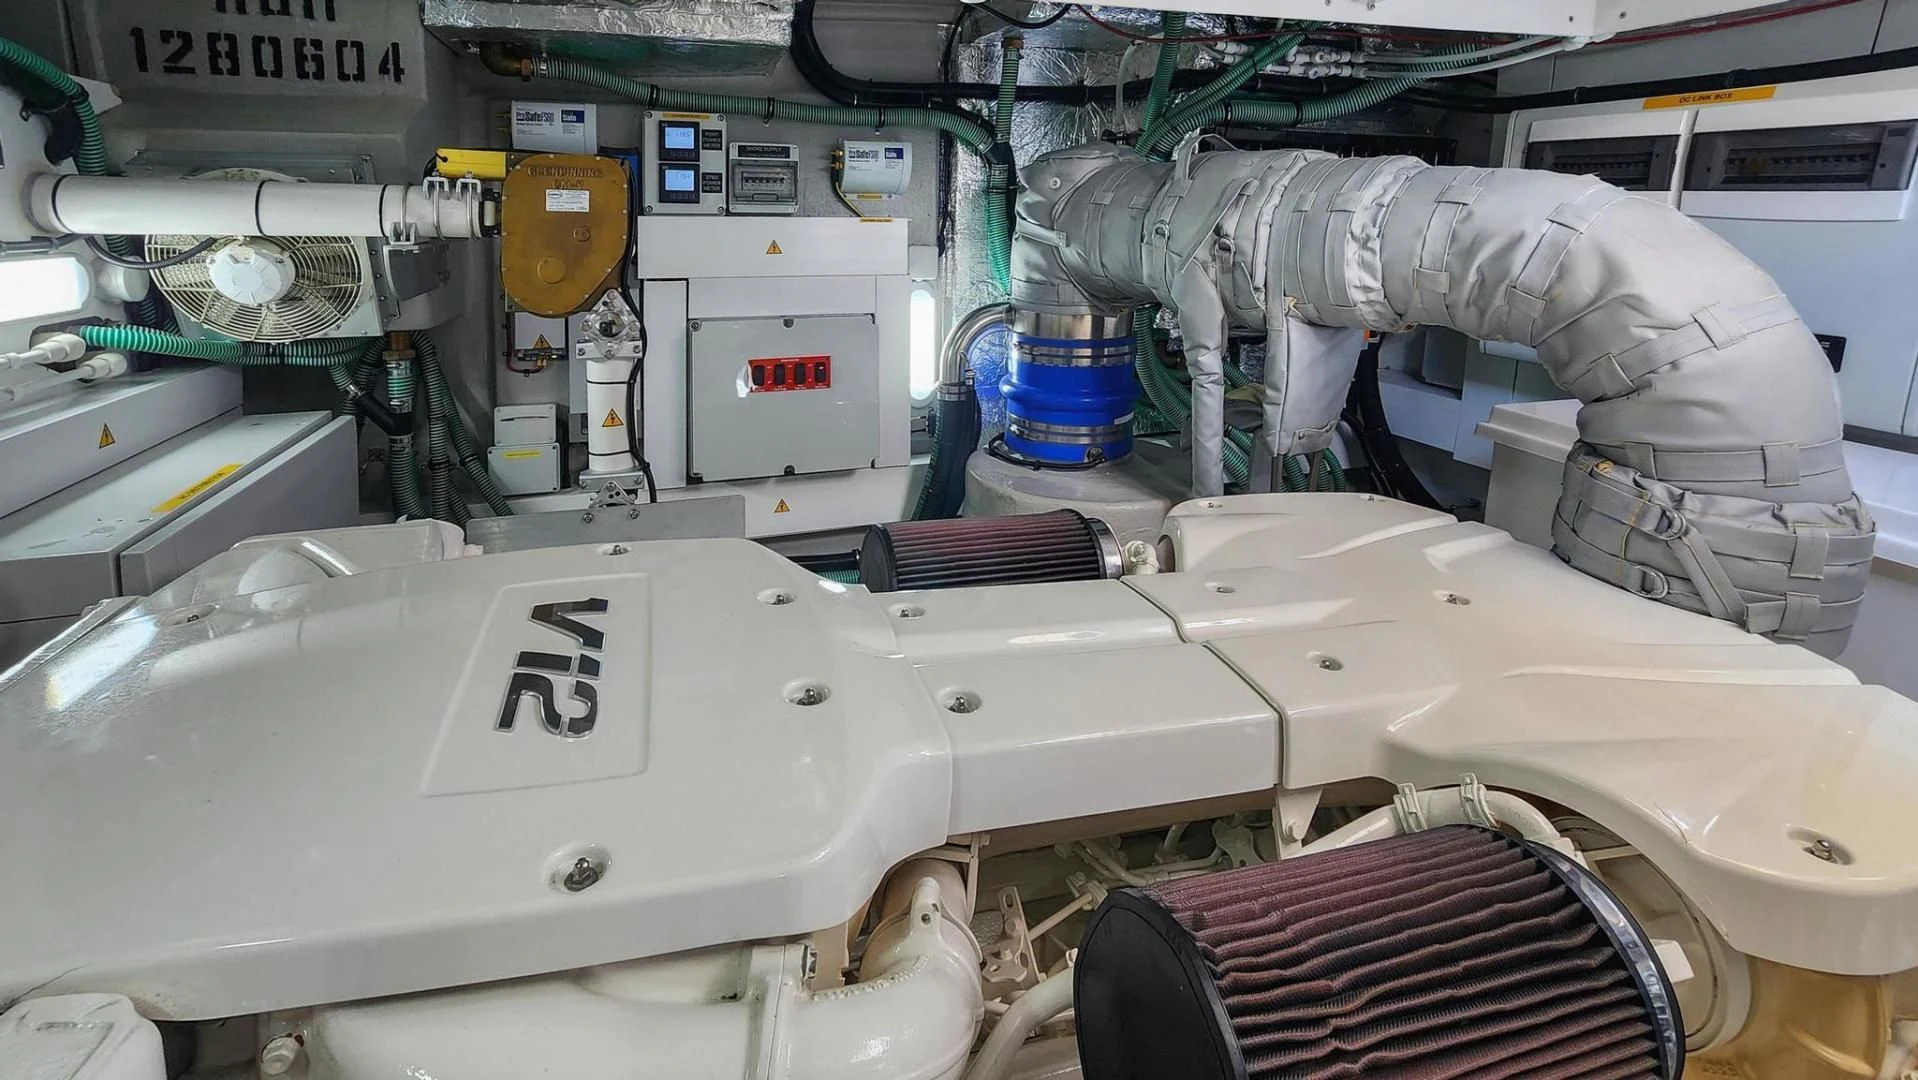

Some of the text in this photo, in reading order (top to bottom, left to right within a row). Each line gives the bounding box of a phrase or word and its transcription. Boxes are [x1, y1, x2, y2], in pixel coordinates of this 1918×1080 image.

[129, 26, 405, 83] 1280604
[1692, 94, 1712, 103] LINK
[1713, 92, 1734, 100] BOX
[494, 597, 609, 739] V12
